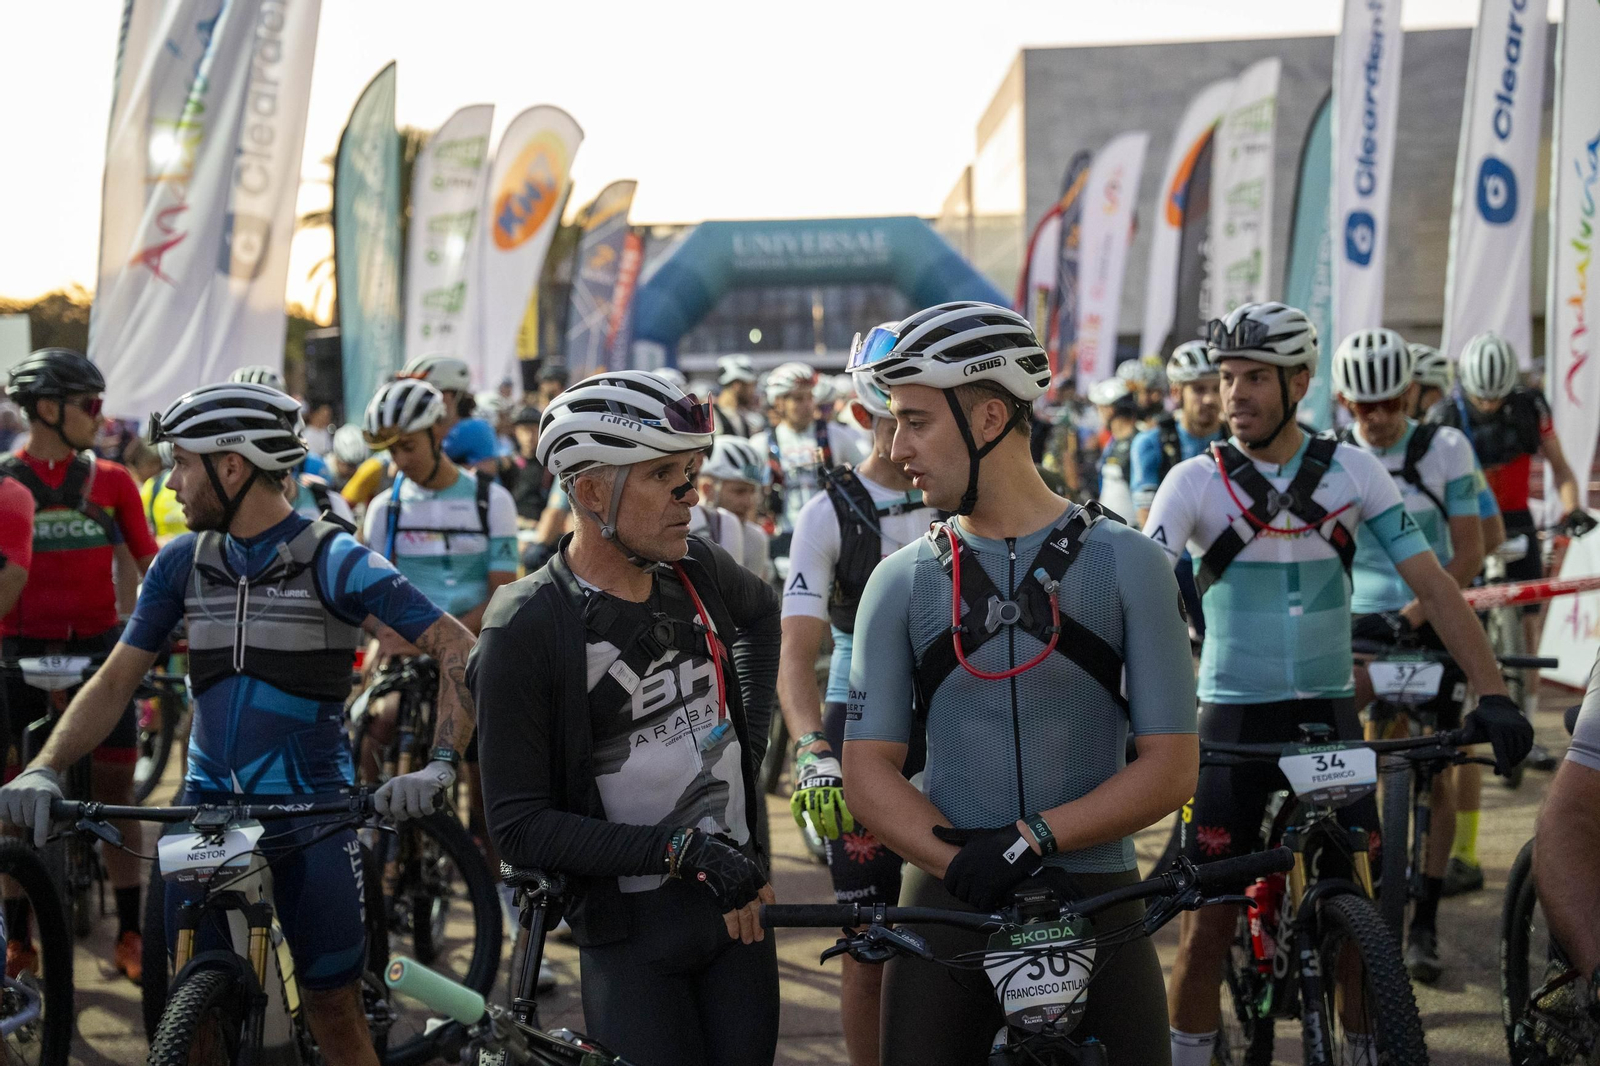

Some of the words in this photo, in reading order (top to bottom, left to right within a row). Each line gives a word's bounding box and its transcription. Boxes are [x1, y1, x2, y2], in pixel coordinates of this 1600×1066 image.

[233, 0, 285, 196] Clearde
[969, 358, 1002, 375] ABUS
[600, 414, 642, 432] GIRO
[32, 519, 106, 540] ROCC
[279, 587, 311, 598] LURBEL
[631, 658, 718, 721] BH
[1311, 753, 1346, 772] 34
[801, 777, 835, 790] LEATT
[1311, 770, 1356, 784] FEDERICO
[191, 831, 226, 850] 24
[186, 850, 226, 861] NÉSTOR
[1026, 950, 1070, 980] 30
[1006, 982, 1059, 1001] FRANCISCO
